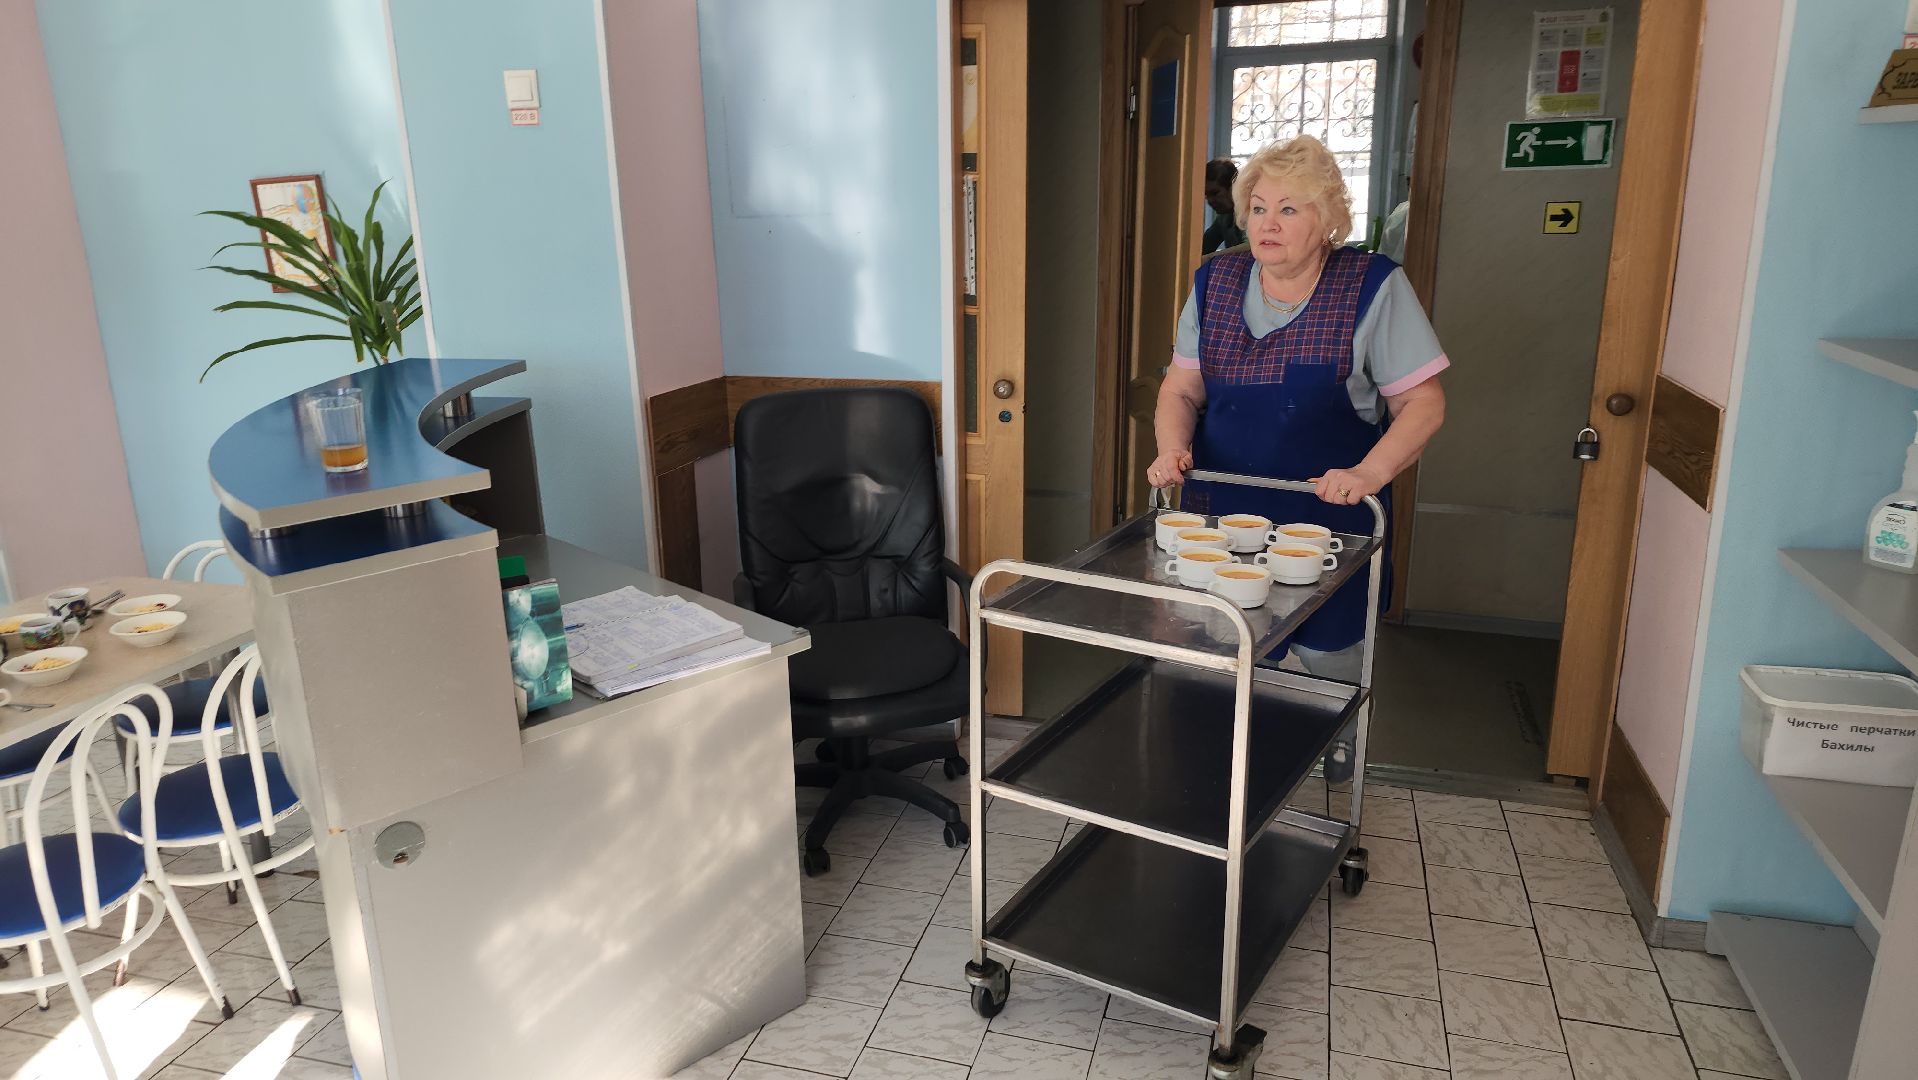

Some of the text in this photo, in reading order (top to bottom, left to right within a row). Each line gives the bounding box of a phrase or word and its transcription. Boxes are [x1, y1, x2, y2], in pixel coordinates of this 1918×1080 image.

[1787, 717, 1916, 737] Чистые перчатки
[1821, 739, 1875, 753] Бахилы
